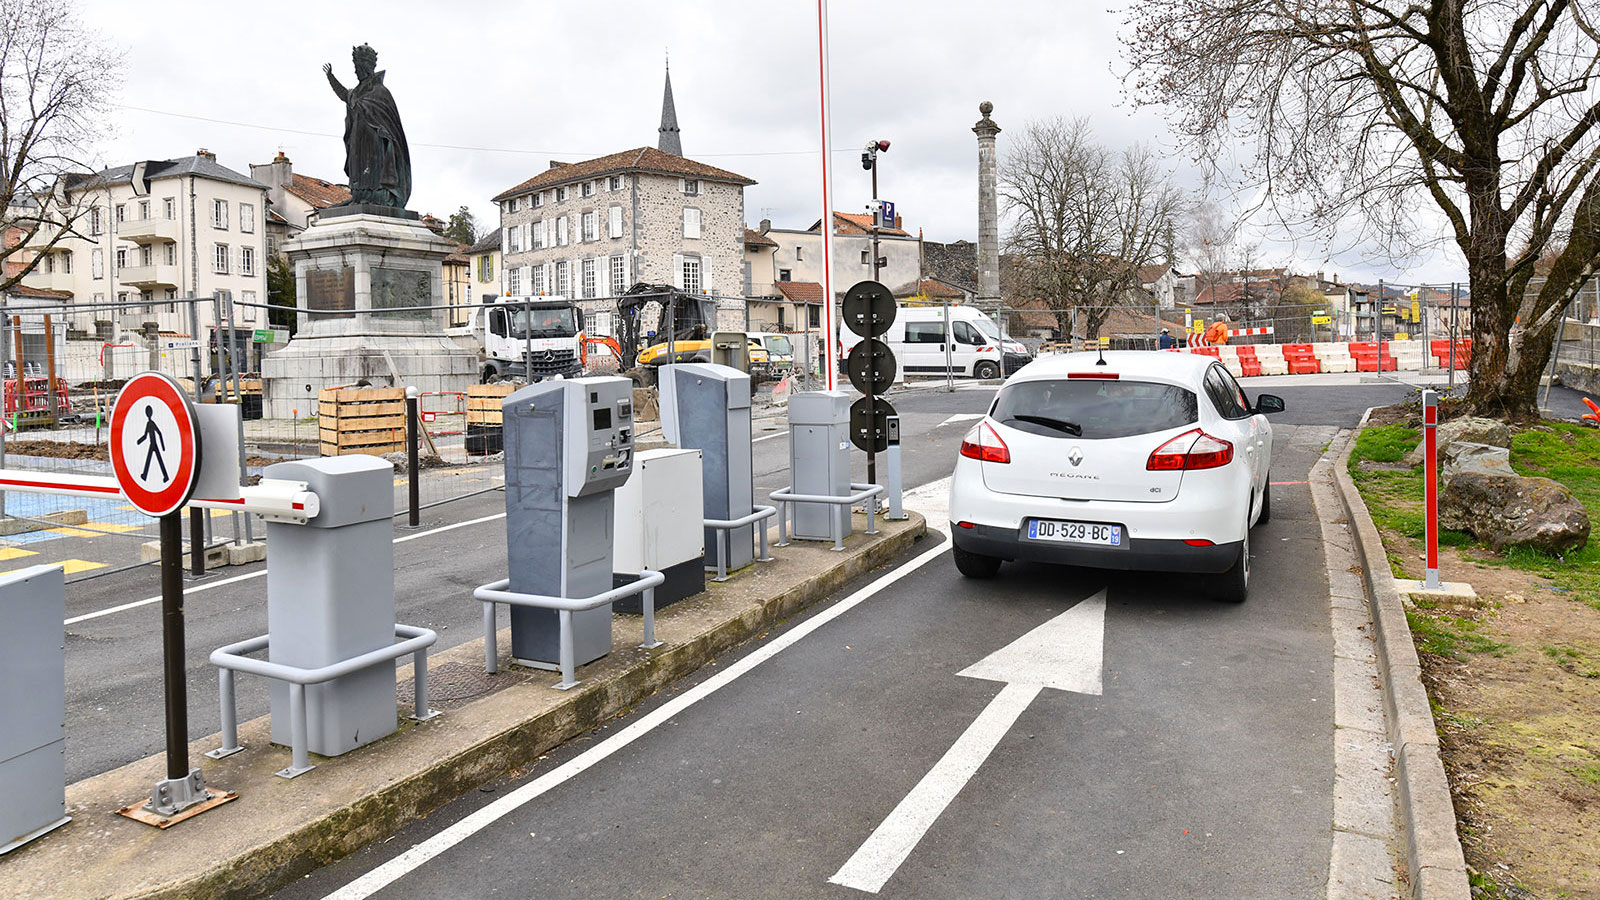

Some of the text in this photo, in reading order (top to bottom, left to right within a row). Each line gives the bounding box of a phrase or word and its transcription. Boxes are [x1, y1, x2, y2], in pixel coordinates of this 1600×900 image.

[886, 202, 891, 215] P
[1038, 522, 1109, 540] DD-529-BC
[1111, 535, 1119, 544] 19
